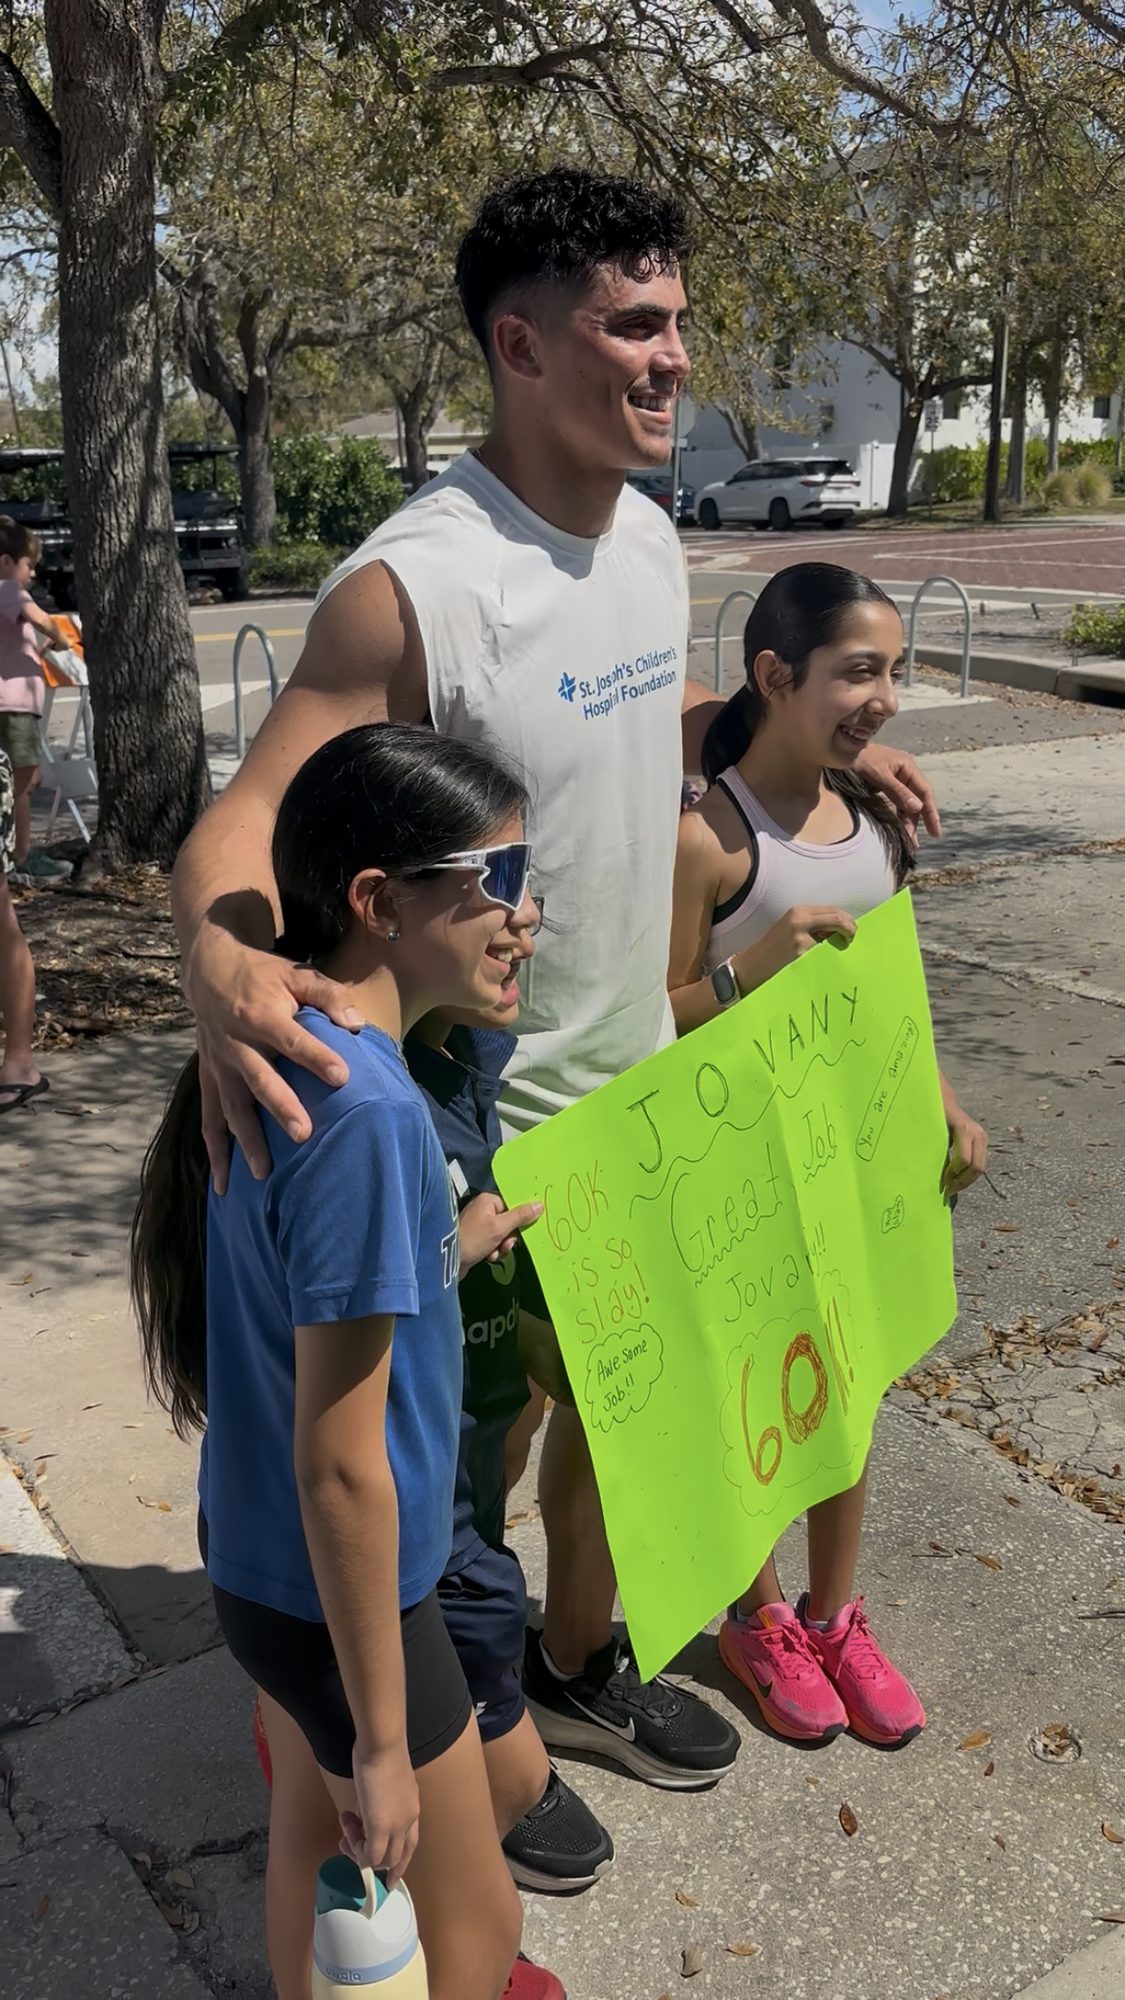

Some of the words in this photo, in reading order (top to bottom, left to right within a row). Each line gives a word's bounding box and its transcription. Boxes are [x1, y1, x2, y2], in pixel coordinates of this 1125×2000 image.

[579, 681, 596, 699] St.
[595, 662, 634, 697] Josh's
[635, 646, 677, 674] Children's
[583, 687, 619, 720] Hospil
[621, 669, 677, 702] Foundation
[627, 986, 859, 1174] JOVANY
[544, 1159, 609, 1251] 60K
[670, 1141, 780, 1273] Great
[802, 1102, 838, 1170] Job
